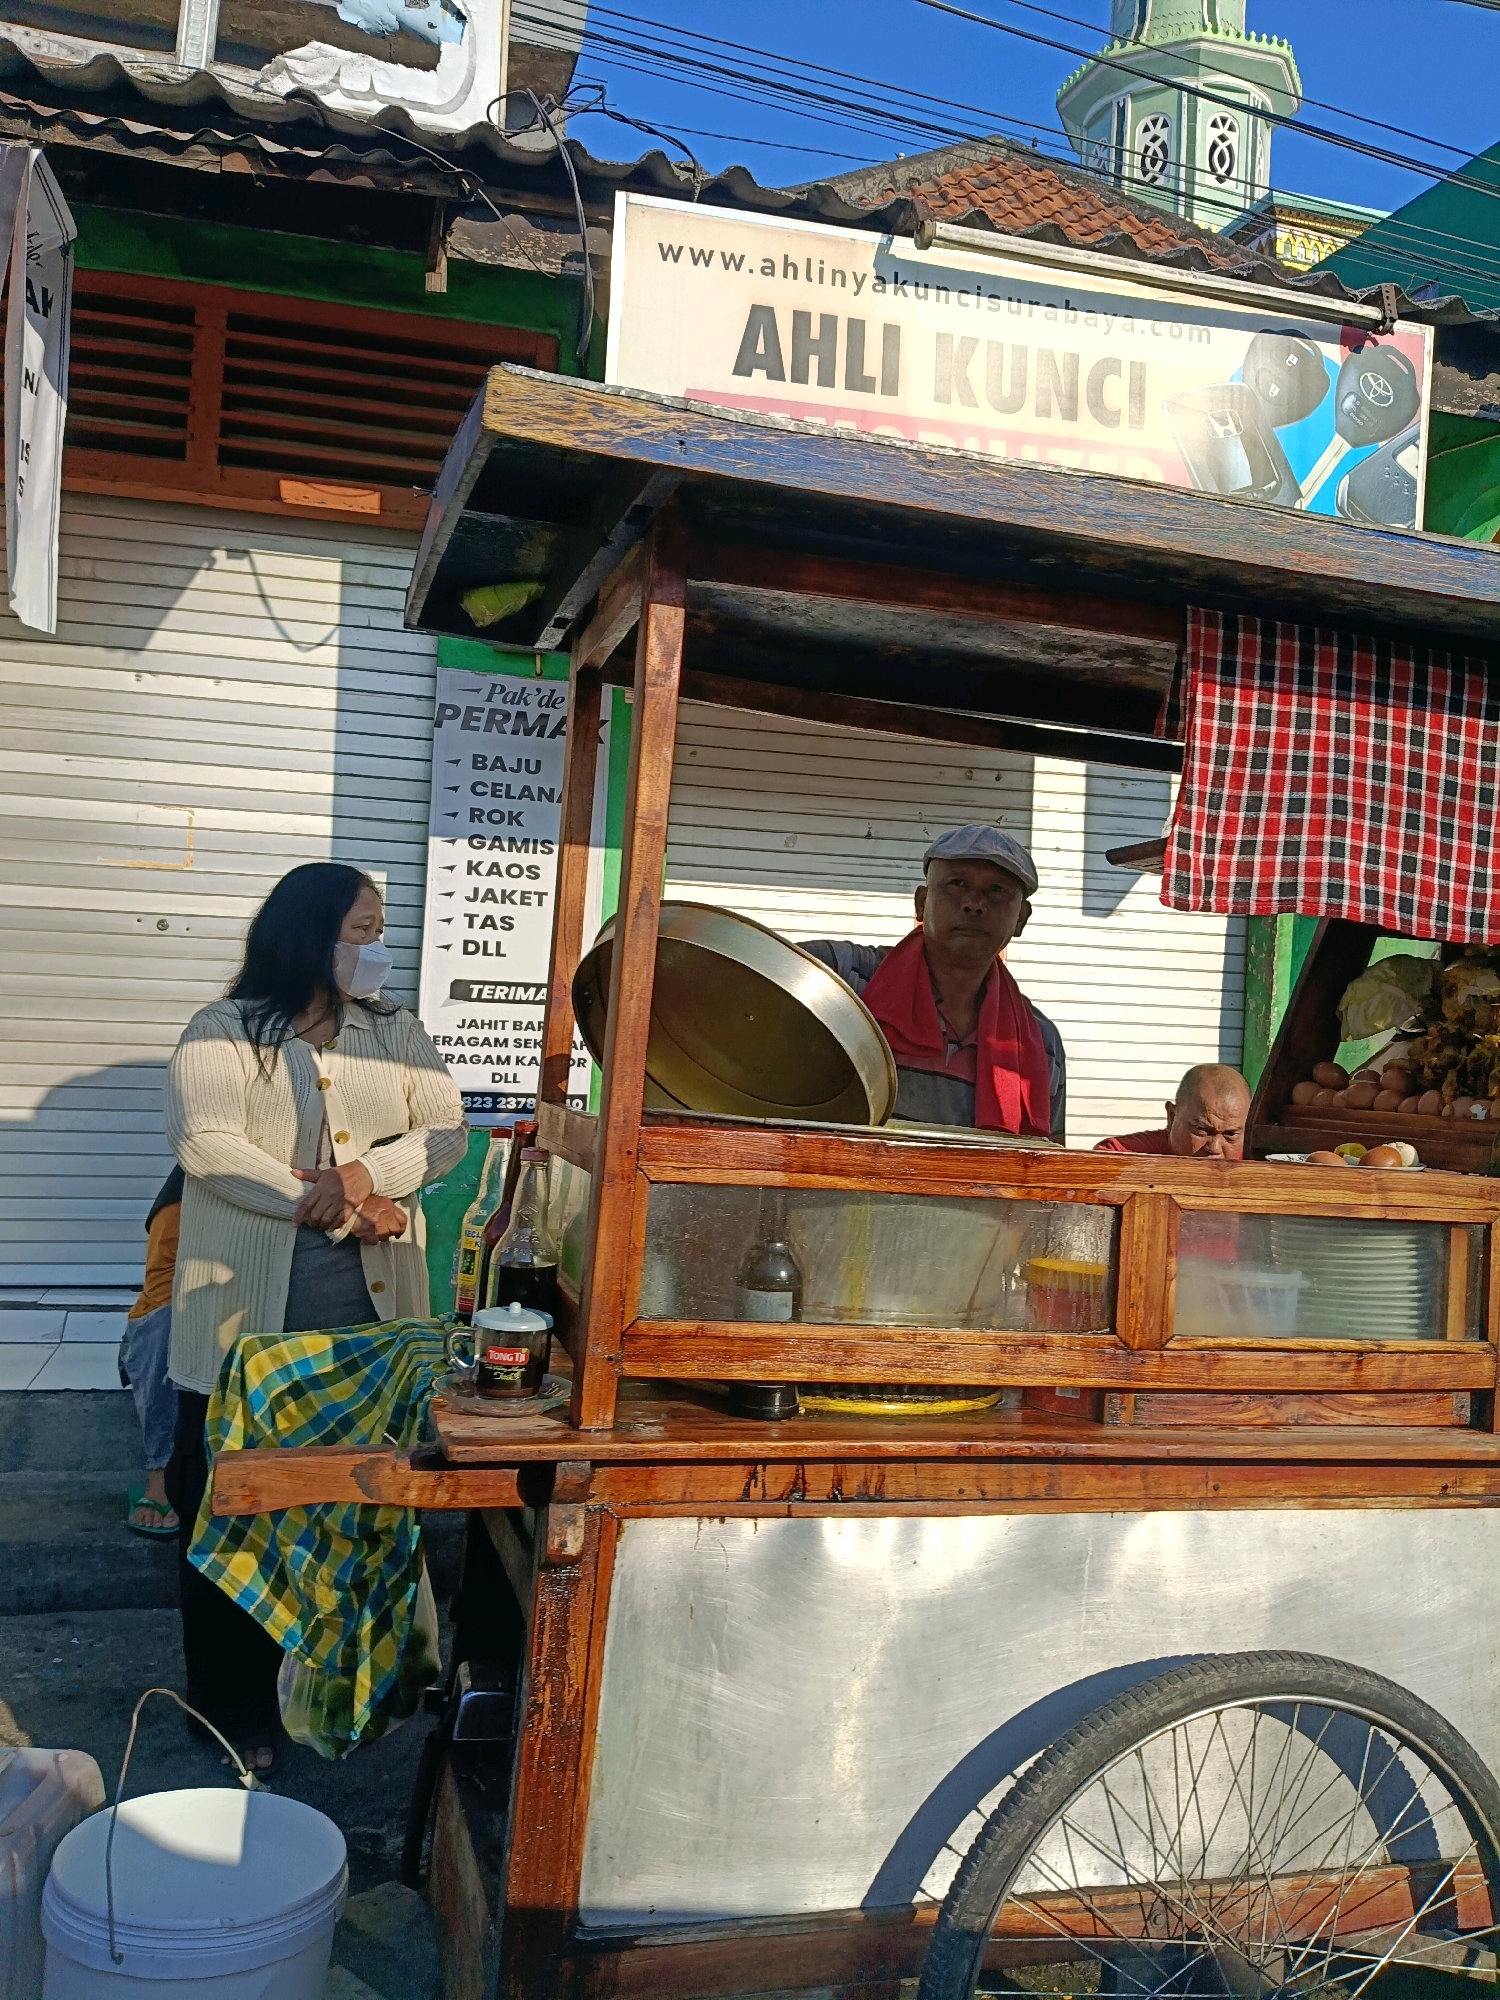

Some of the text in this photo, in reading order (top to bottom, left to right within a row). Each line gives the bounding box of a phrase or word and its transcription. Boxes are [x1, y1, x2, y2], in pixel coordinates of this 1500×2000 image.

[658, 241, 1212, 345] www.ahlinyakuncisurabaya.com
[732, 303, 1147, 430] AHLI KUNCI
[471, 753, 542, 775] BAJU
[468, 807, 525, 828] ROK
[467, 833, 555, 856] GAMIS
[466, 859, 541, 881] KAOS
[464, 886, 549, 907] JAKET
[463, 912, 515, 932] TAS
[462, 938, 507, 958] DLL
[456, 1018, 509, 1031] JAHIT
[432, 1034, 509, 1048] ERAGAM
[491, 1071, 521, 1084] DLL
[462, 1096, 537, 1110] 823 2378
[488, 1350, 513, 1362] TONG
